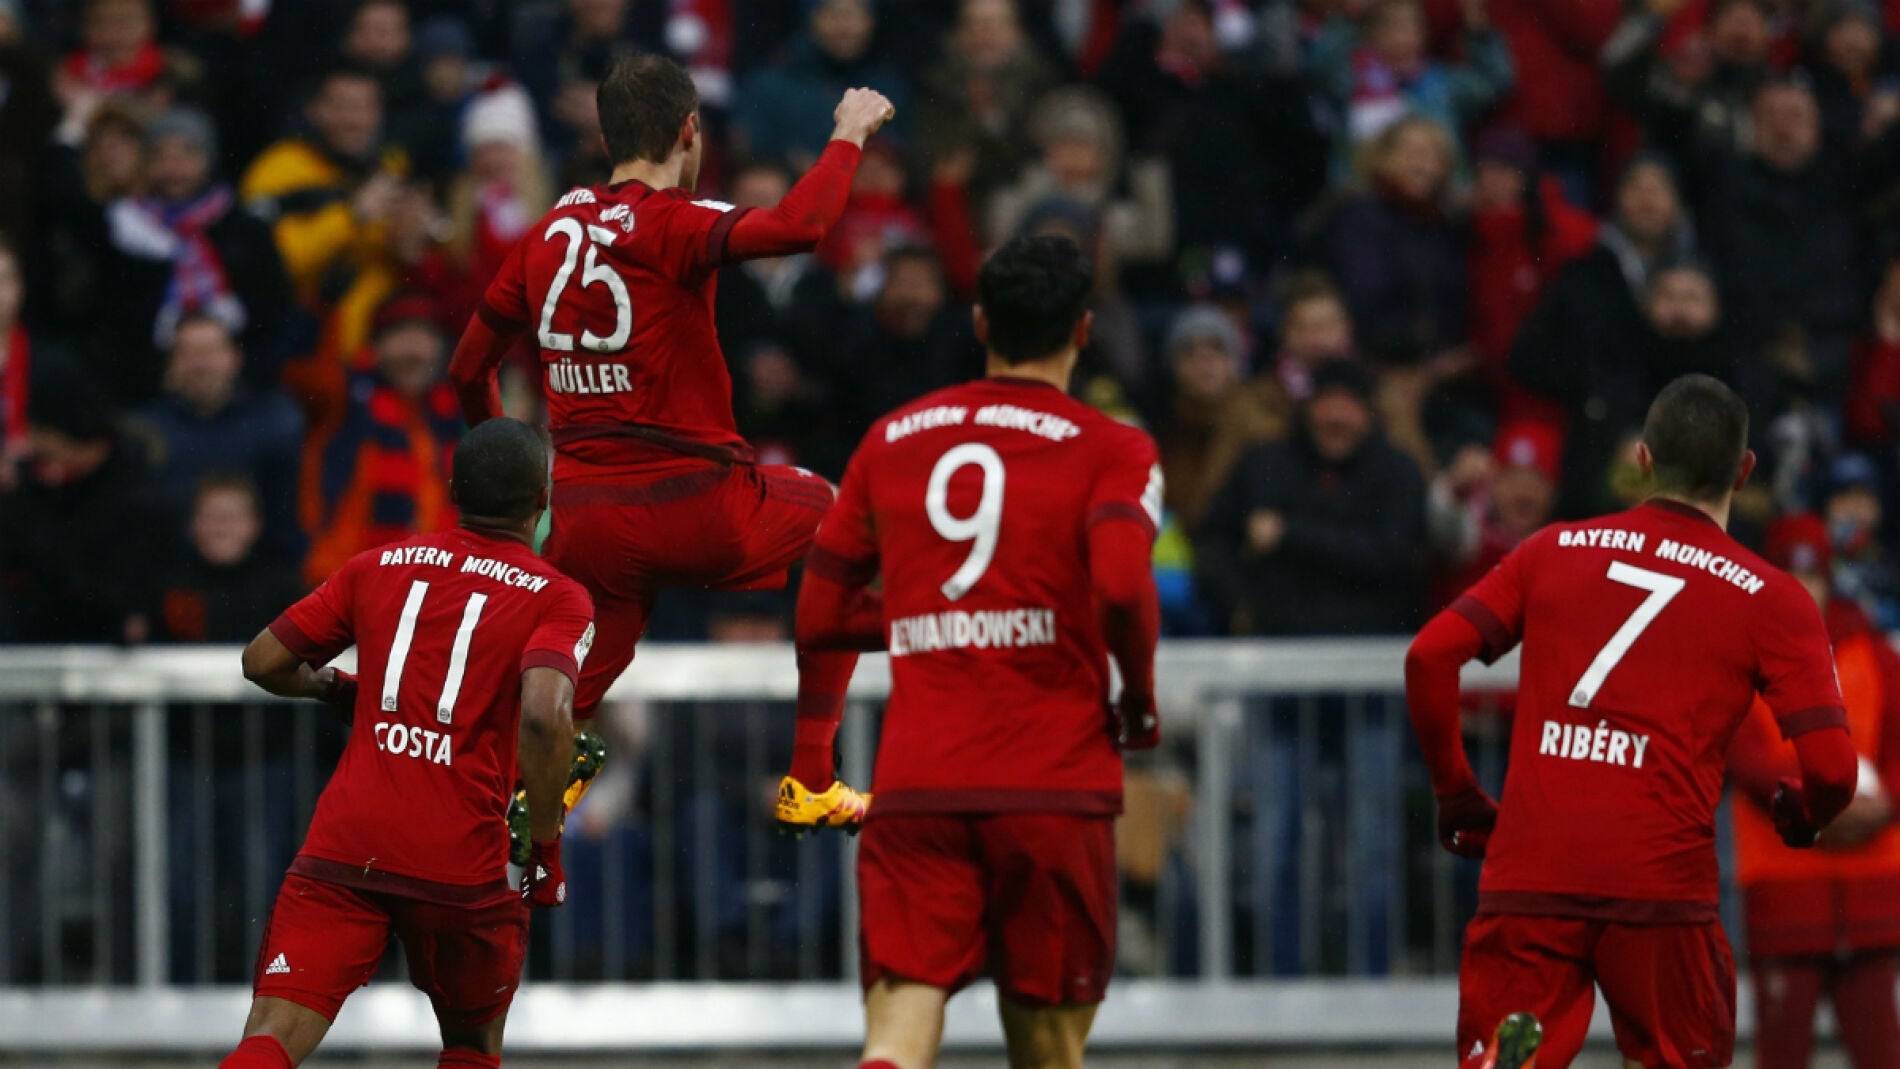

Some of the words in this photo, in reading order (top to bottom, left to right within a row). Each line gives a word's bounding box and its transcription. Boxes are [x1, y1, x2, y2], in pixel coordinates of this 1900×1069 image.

[537, 216, 633, 351] 25
[549, 357, 633, 394] MÜLLER
[925, 442, 1006, 601] 9
[1558, 529, 1646, 552] BAYERN
[379, 546, 454, 568] BAYERN
[380, 579, 490, 725] 11
[1568, 559, 1687, 709] 7
[374, 721, 452, 766] COSTA
[1539, 719, 1650, 769] RIBÉRY
